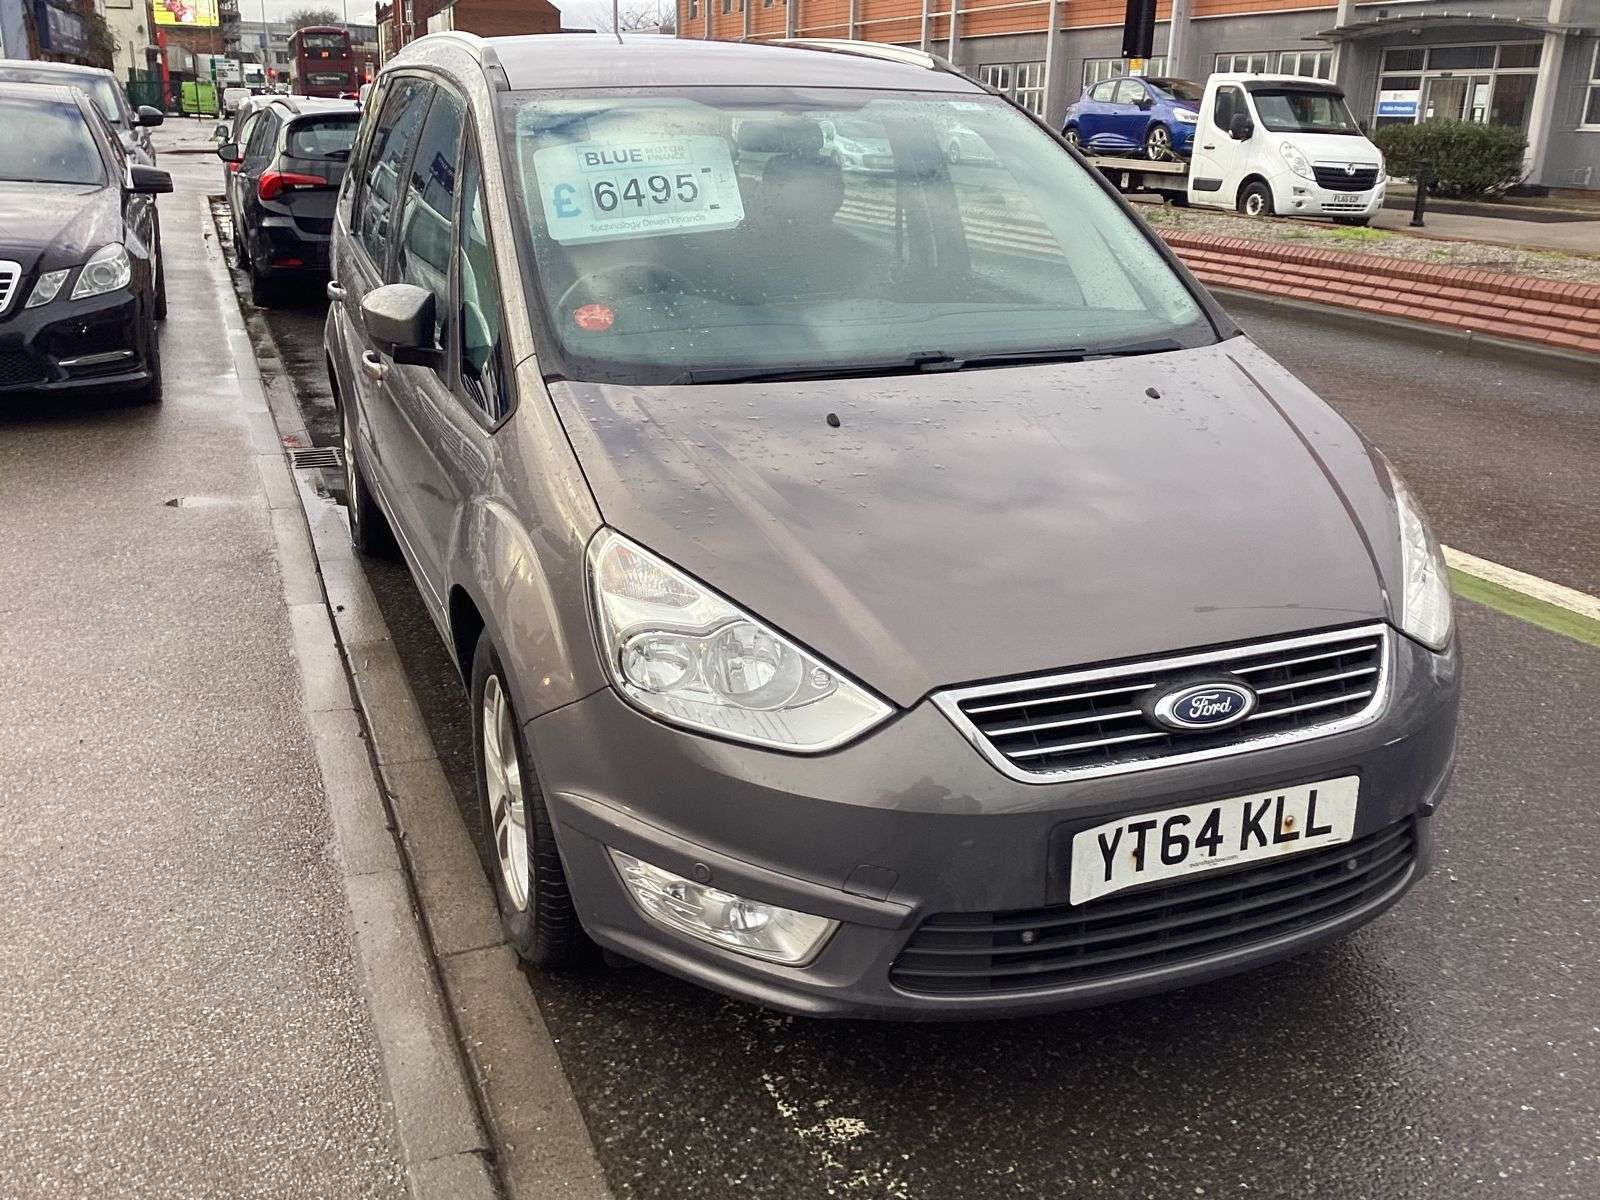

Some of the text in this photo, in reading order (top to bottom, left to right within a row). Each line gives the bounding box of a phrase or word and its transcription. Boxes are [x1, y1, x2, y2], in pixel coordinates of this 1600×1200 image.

[584, 148, 643, 166] BLUE
[552, 173, 699, 219] £ 6495
[1189, 693, 1233, 718] Ford
[1097, 789, 1332, 882] YT64 KLL
